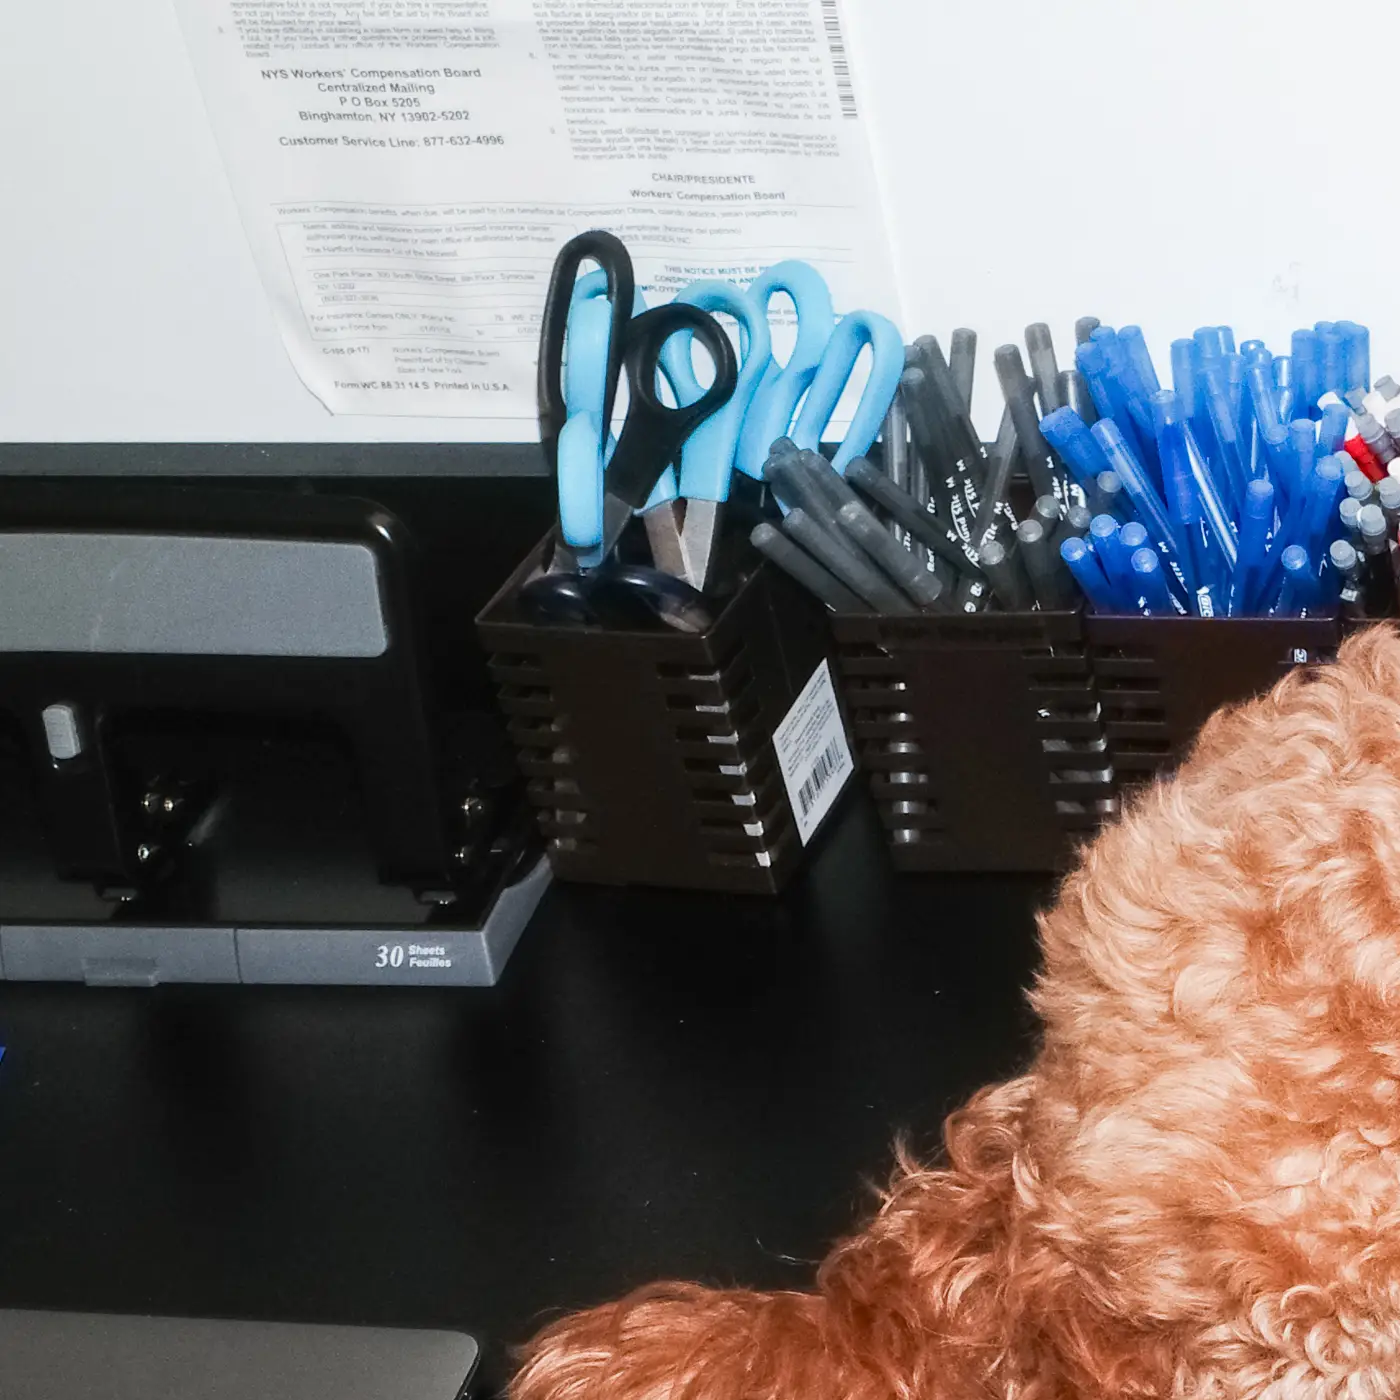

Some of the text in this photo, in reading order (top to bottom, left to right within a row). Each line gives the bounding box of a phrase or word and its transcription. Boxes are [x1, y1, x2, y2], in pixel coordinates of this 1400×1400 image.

[260, 67, 482, 82] NYS Workers' Compensation Board
[317, 82, 436, 95] Centralized Mailing
[338, 96, 421, 107] P O Box 5205
[298, 110, 471, 124] Binghamton, NY 13902-5202
[278, 133, 505, 148] Customer Service Line: 877-632-4996
[651, 172, 757, 185] CHAIR/PRESIDENTE
[629, 188, 786, 202] Workers' Compensation Board
[375, 945, 404, 968] 30
[408, 944, 446, 956] Sheets
[409, 957, 452, 968] Feuilles
